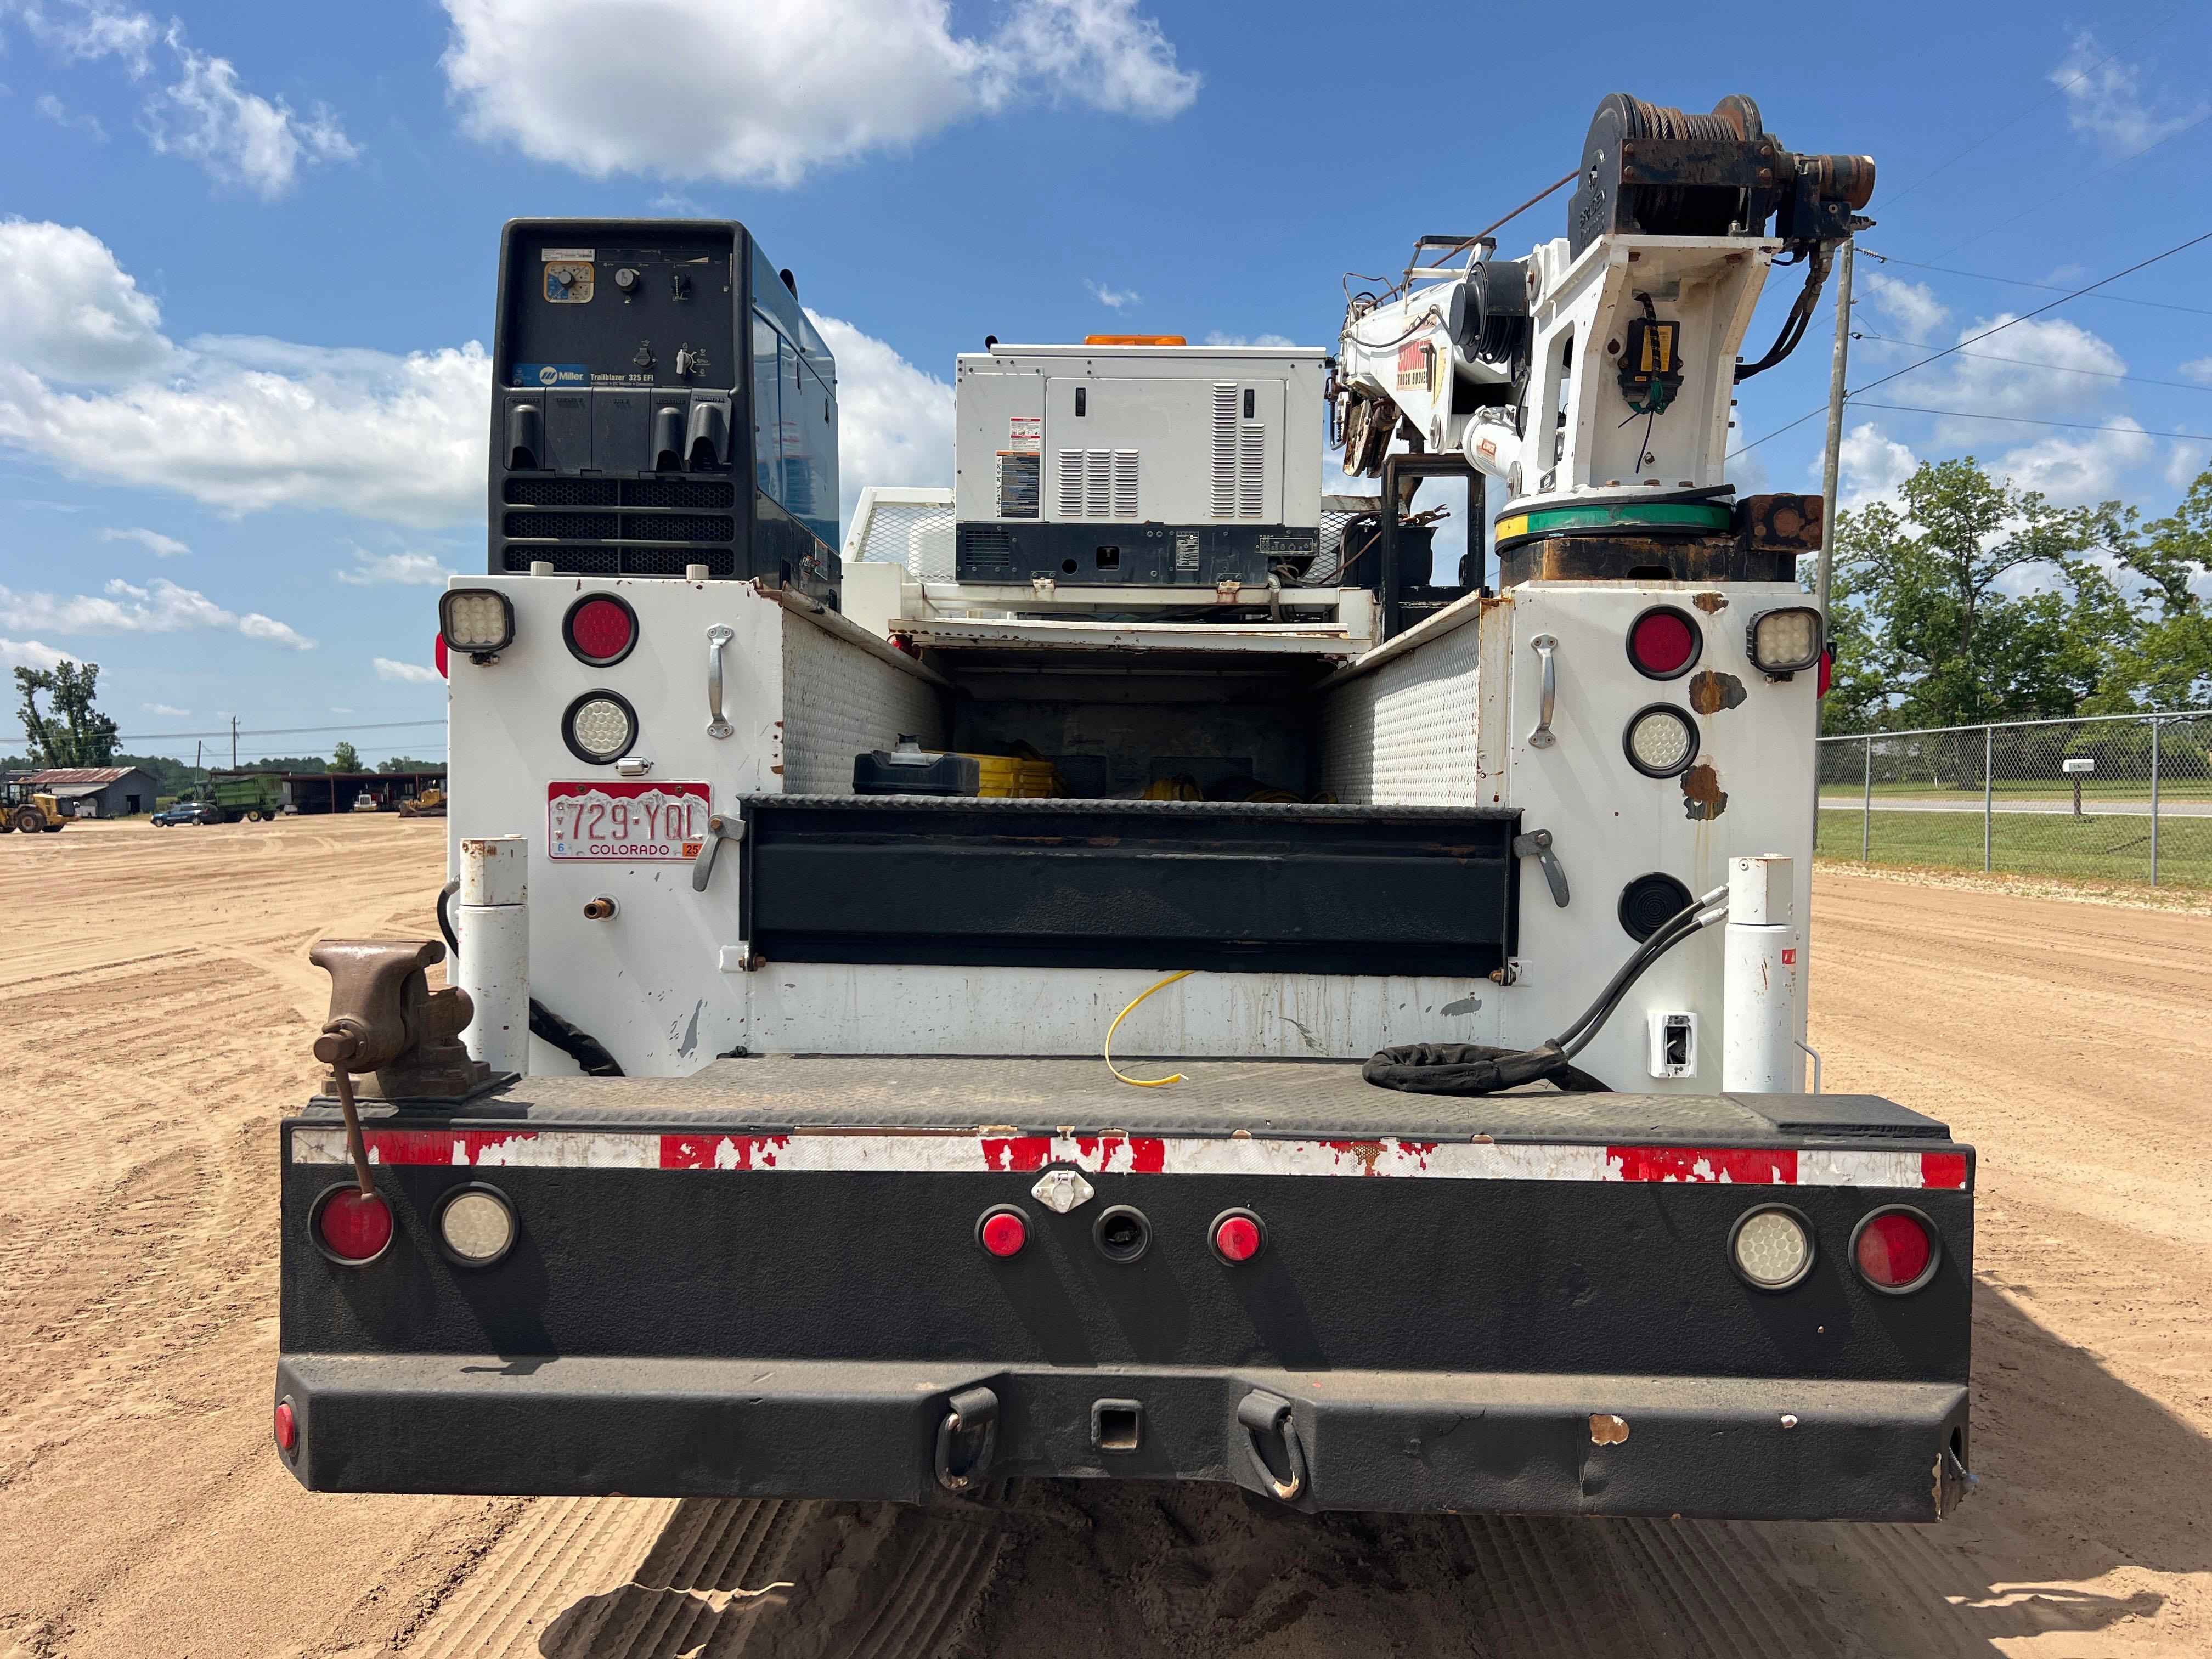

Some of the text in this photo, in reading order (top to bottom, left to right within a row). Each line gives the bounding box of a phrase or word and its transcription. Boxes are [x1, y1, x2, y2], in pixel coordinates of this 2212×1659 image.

[559, 371, 583, 380] Miller
[1397, 373, 1411, 386] TRUCK
[558, 843, 565, 852] 6
[590, 844, 669, 855] COLORADO
[686, 845, 698, 854] 25
